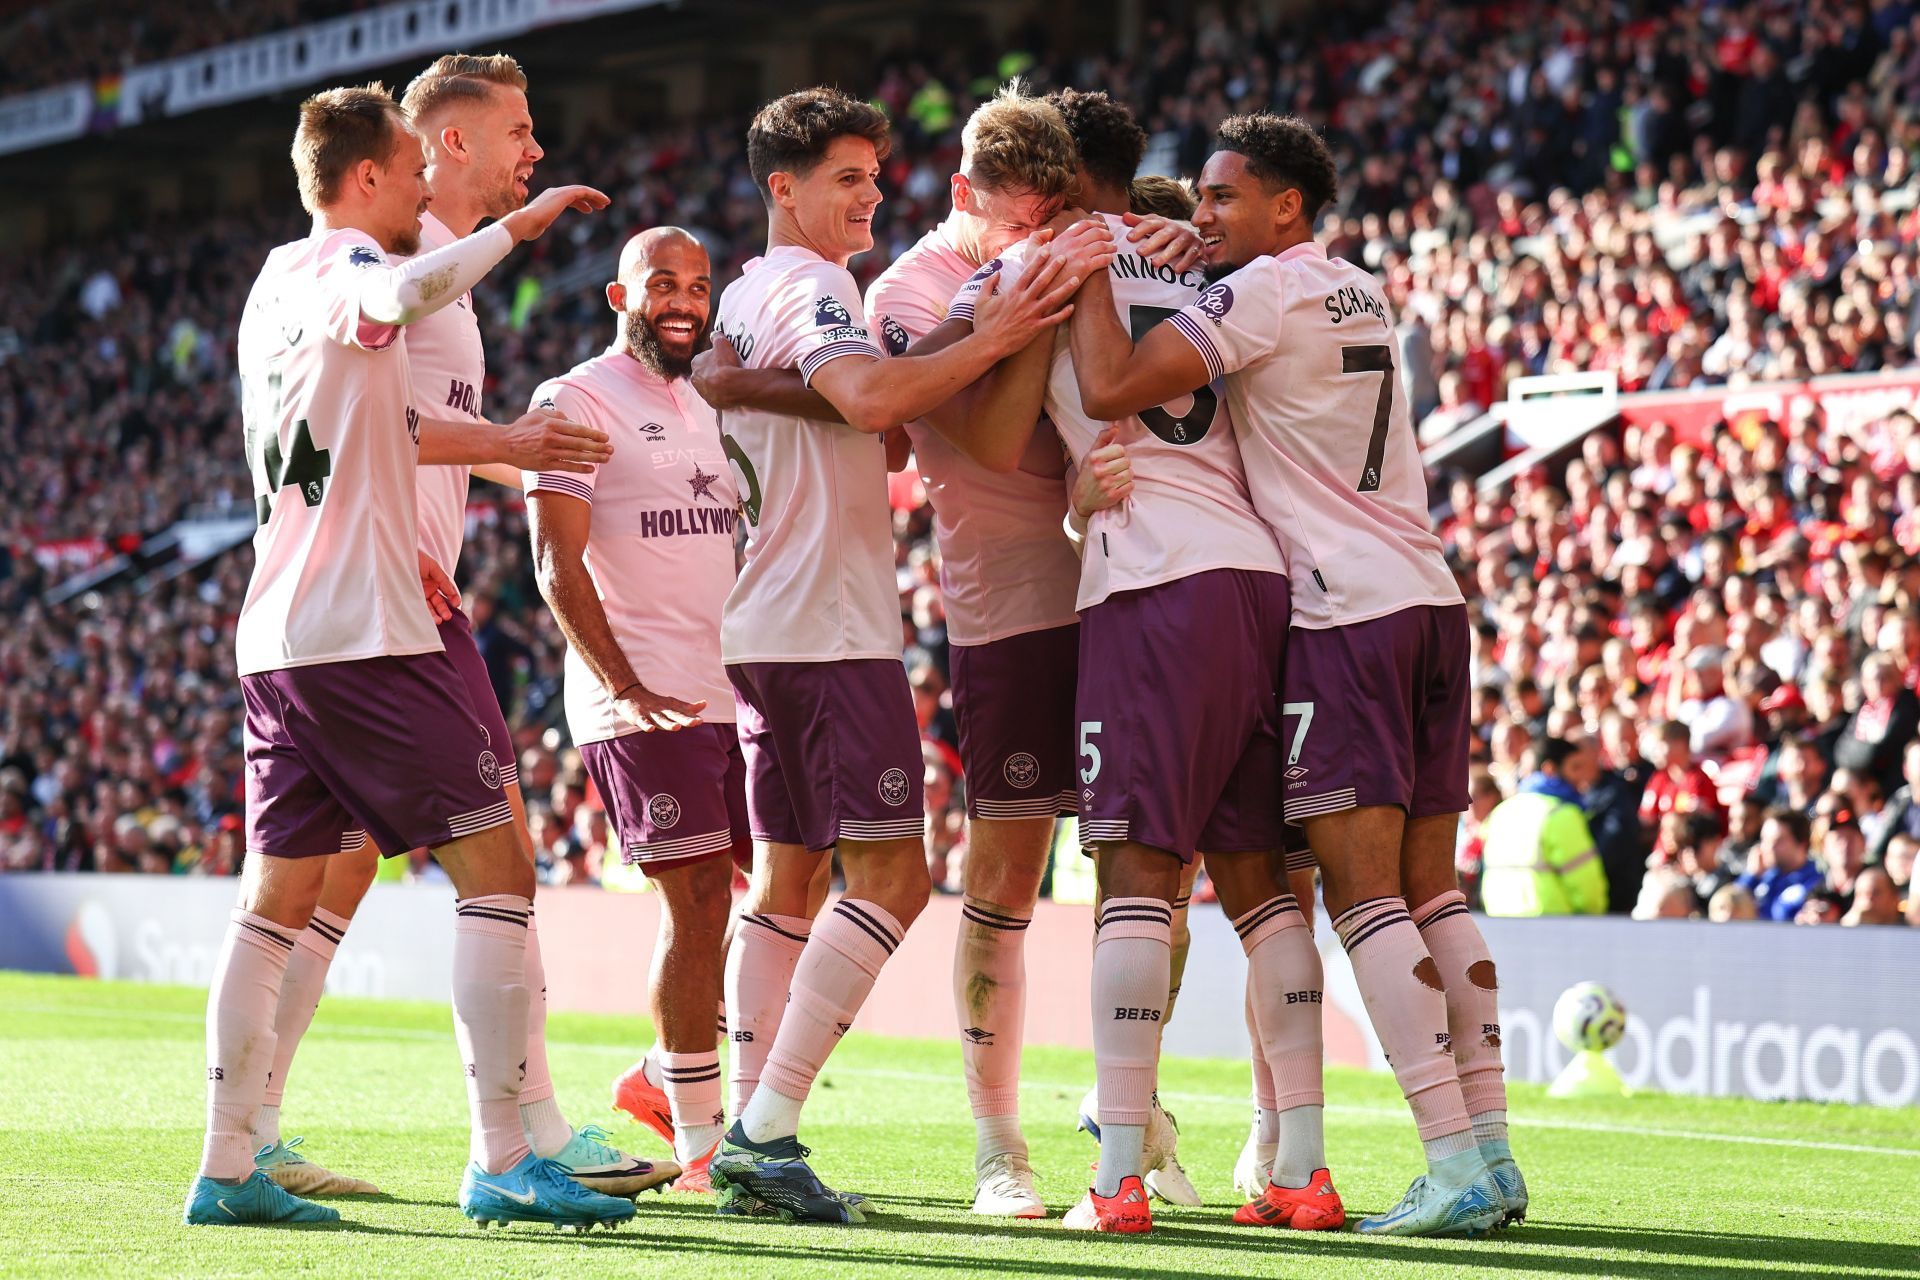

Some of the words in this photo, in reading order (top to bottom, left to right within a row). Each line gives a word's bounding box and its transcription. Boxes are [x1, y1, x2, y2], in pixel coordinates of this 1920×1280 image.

[1341, 345, 1395, 492] 7
[645, 434, 666, 442] umbro
[1282, 701, 1315, 765] 7
[1080, 721, 1103, 785] 5
[1287, 780, 1308, 790] umbro
[1284, 990, 1323, 1005] BEES
[1113, 1007, 1161, 1022] BEES
